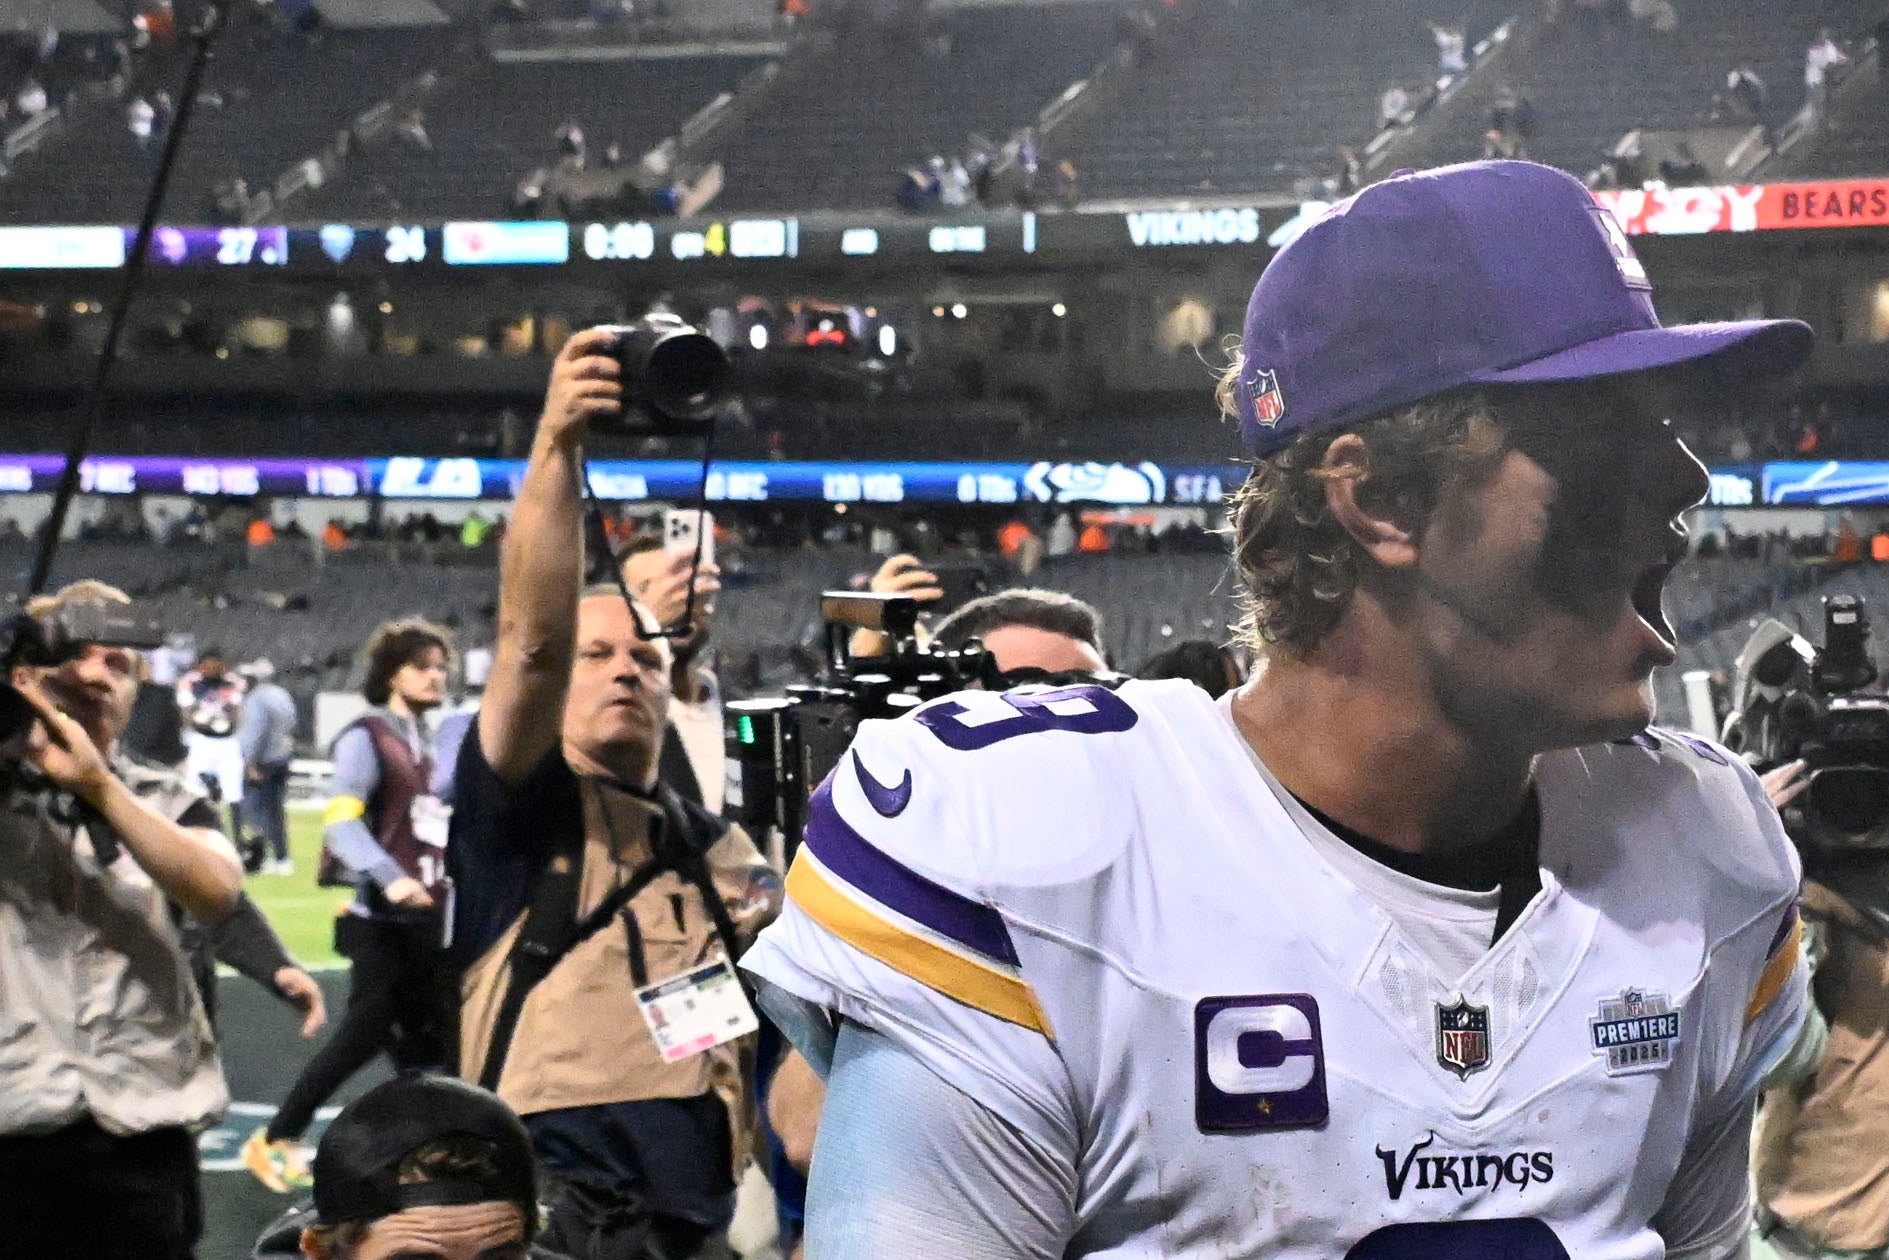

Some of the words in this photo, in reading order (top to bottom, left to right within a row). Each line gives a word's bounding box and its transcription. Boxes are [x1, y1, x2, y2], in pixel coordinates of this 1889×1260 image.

[1783, 189, 1887, 220] BEARS
[1126, 207, 1260, 247] VIKINGS
[914, 685, 1138, 751] 9
[1206, 1004, 1316, 1095] C
[1443, 1031, 1486, 1066] NFL
[1619, 1044, 1660, 1066] 2025
